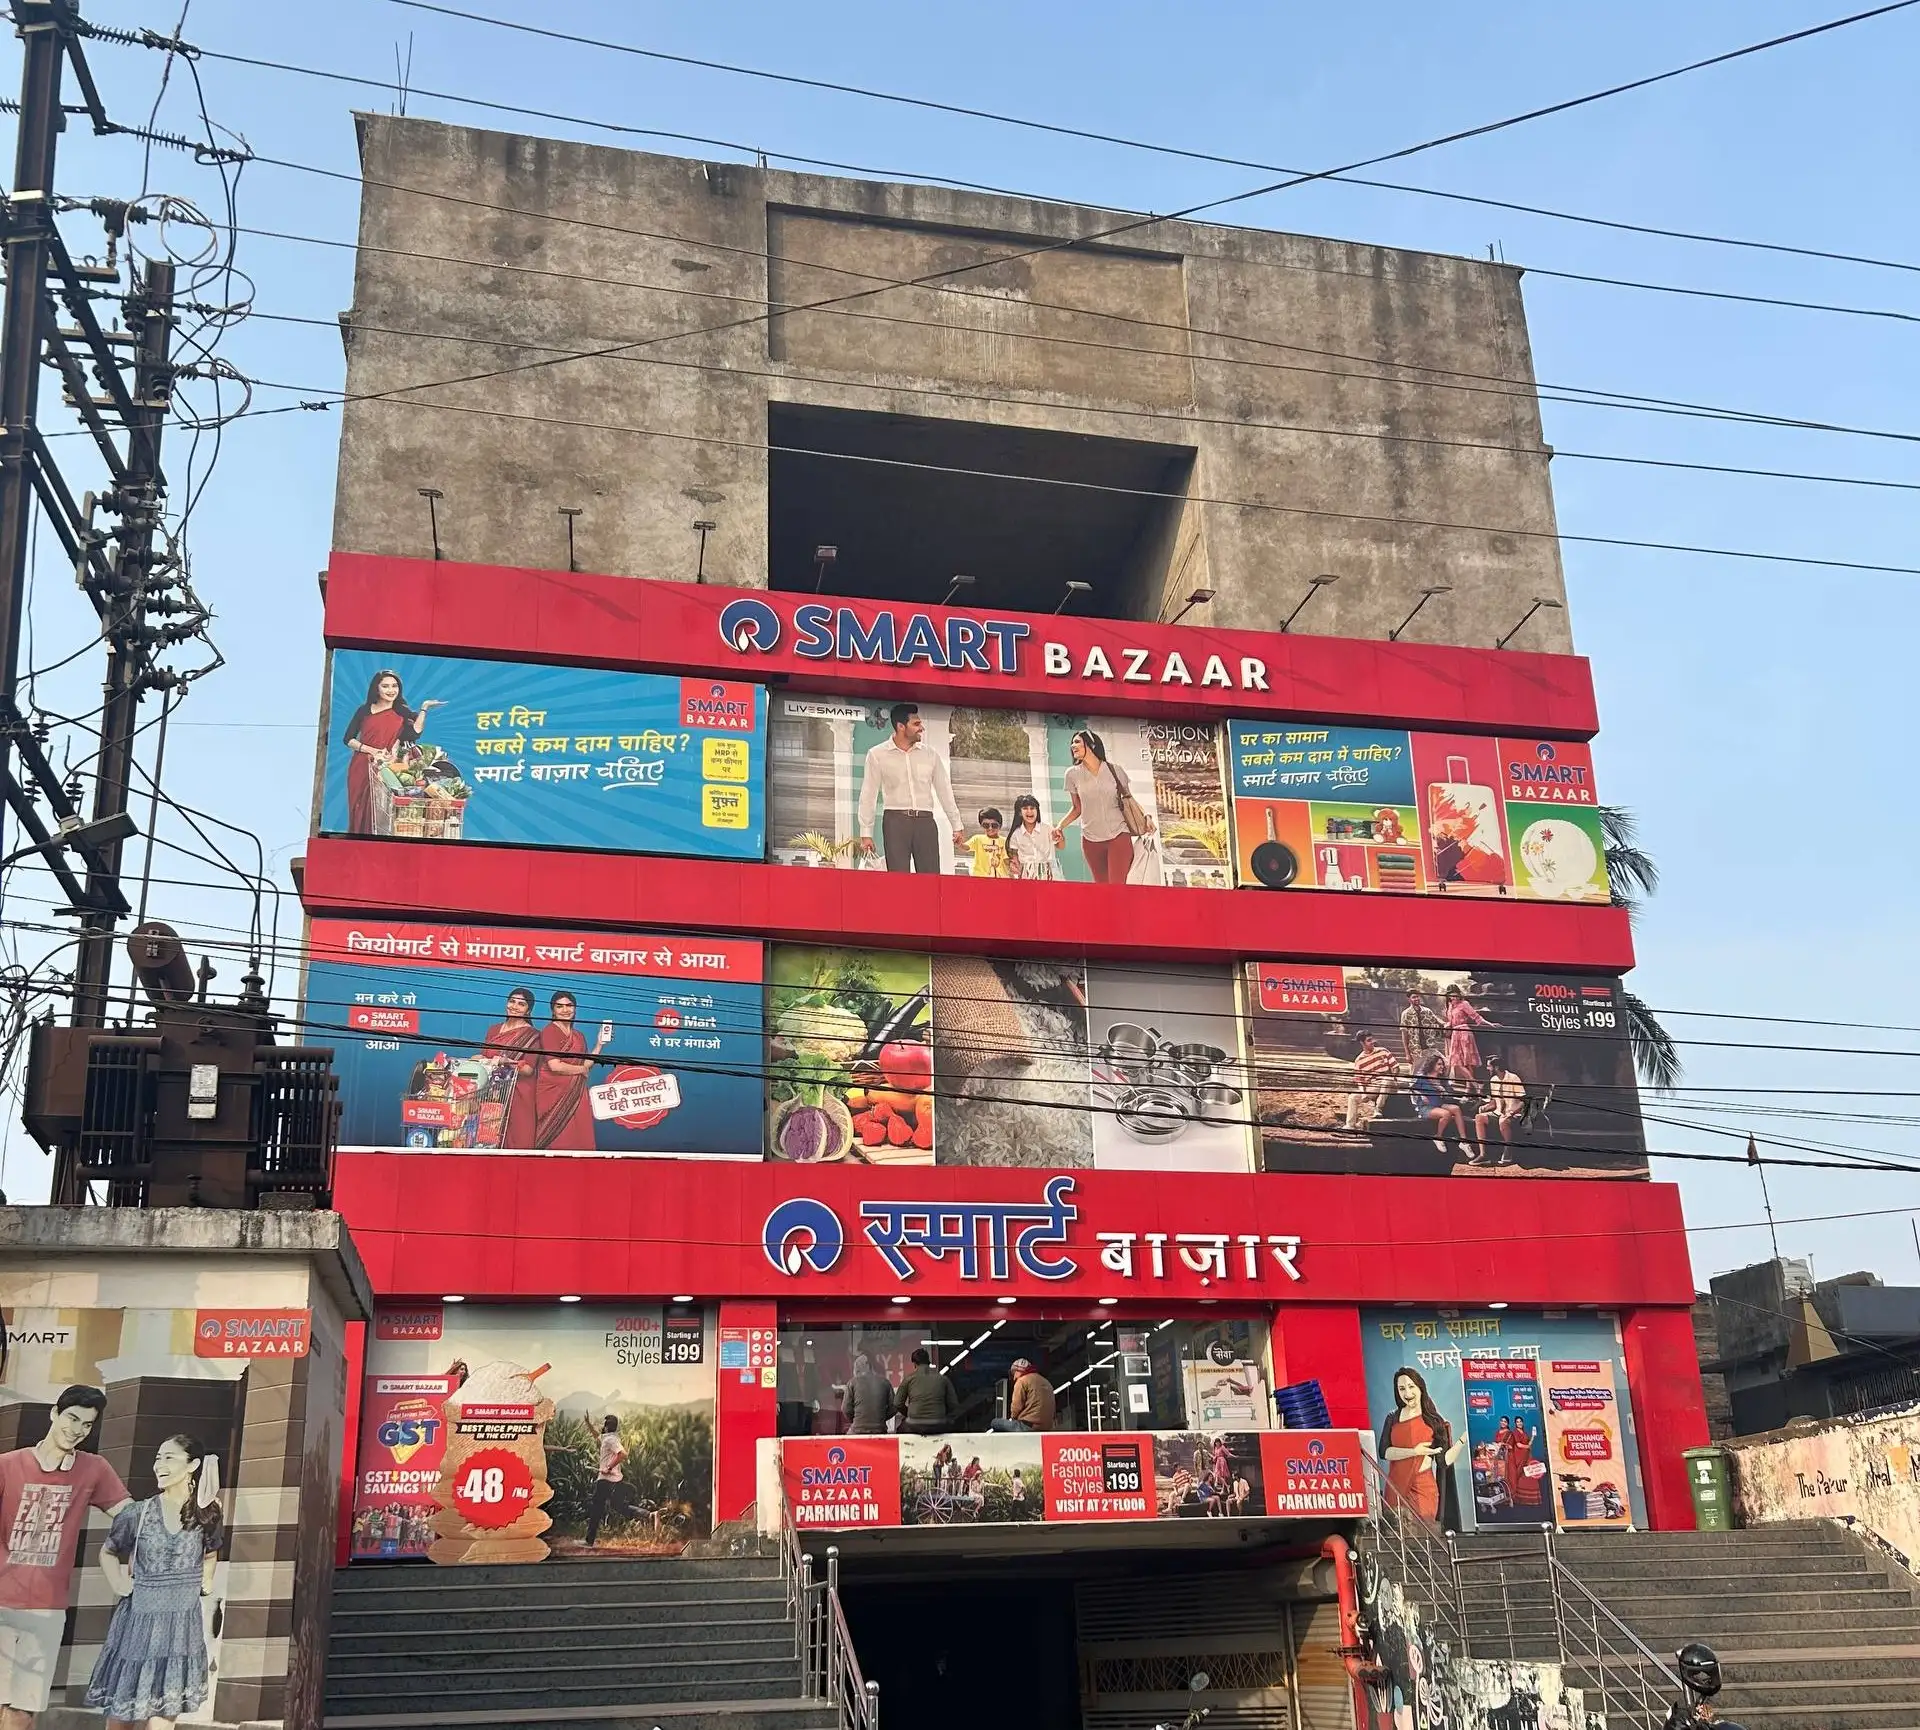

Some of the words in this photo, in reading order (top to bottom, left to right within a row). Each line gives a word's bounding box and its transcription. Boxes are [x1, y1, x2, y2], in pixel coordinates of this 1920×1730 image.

[794, 602, 1029, 674] SMART
[1044, 641, 1271, 692] BAZAAR
[687, 697, 749, 716] SMART
[476, 711, 504, 731] हर
[509, 705, 548, 729] दिन
[686, 714, 748, 728] BAZAAR
[1138, 723, 1210, 741] FASHION
[1240, 734, 1258, 746] घर
[1262, 732, 1282, 745] का
[1285, 731, 1329, 744] सामान
[475, 733, 527, 756] सबसे
[532, 738, 569, 753] कम
[574, 736, 613, 755] दाम
[618, 729, 691, 754] चाहिए?
[714, 748, 731, 757] MRP
[1140, 748, 1211, 765] EVERYDAY
[1241, 749, 1276, 767] सबसे
[1279, 752, 1305, 765] कम
[1308, 750, 1333, 765] दाम
[1337, 745, 1349, 762] में
[1352, 743, 1402, 762] चाहिए?
[474, 759, 526, 783] स्मार्ट
[530, 763, 591, 784] बाज़ार
[595, 756, 665, 782] चलिए
[1242, 769, 1277, 787] स्मार्ट
[1326, 765, 1369, 783] चलिए
[1509, 761, 1588, 785] SMART
[1511, 785, 1591, 802] BAZAAR
[346, 931, 434, 957] जियोमार्ट
[439, 938, 461, 957] से
[535, 941, 584, 963] स्मार्ट
[653, 945, 673, 967] से
[1281, 978, 1337, 993] SMART
[1534, 984, 1577, 999] 2000+
[354, 993, 375, 1003] मन
[377, 991, 399, 1004] करे
[402, 991, 417, 1005] तो
[1282, 993, 1339, 1005] BAZAAR
[371, 1012, 405, 1020] SMART
[371, 1020, 410, 1028] BAZAAR
[657, 1014, 680, 1026] Jio
[684, 1015, 717, 1028] Mart
[1541, 1013, 1581, 1032] Styles
[649, 1034, 661, 1047] से
[664, 1037, 681, 1048] घर
[683, 1035, 722, 1049] मंगाओ
[597, 1086, 618, 1101] वही
[608, 1097, 629, 1111] वही
[860, 1175, 1077, 1281] स्मार्ट
[1097, 1231, 1302, 1287] बाज़ार
[225, 1318, 305, 1338] SMART
[392, 1326, 439, 1335] BAZAAR
[615, 1317, 660, 1332] 2000+
[1379, 1321, 1408, 1341] घर
[1412, 1320, 1439, 1340] का
[1444, 1317, 1502, 1339] सामान
[605, 1332, 661, 1348] Fashion
[667, 1332, 692, 1340] Starting
[224, 1341, 304, 1353] BAZAAR
[617, 1350, 660, 1367] Styles
[1416, 1342, 1462, 1369] सबसे
[377, 1418, 441, 1447] GST
[484, 1425, 505, 1433] RICE
[506, 1425, 533, 1433] PRICE
[1568, 1433, 1605, 1441] EXCHANGE
[1059, 1448, 1100, 1462] 2000+
[1051, 1462, 1102, 1478] Fashion
[1106, 1461, 1129, 1469] Starting
[1286, 1457, 1349, 1476] SMART
[365, 1470, 392, 1483] GST
[802, 1466, 872, 1486] SMART
[1287, 1478, 1352, 1490] BAZAAR
[364, 1482, 419, 1494] SAVINGS
[1063, 1479, 1103, 1497] Styles
[1794, 1472, 1816, 1498] The
[801, 1487, 873, 1501] BAZAAR
[1277, 1493, 1336, 1510] PARKING
[1338, 1492, 1365, 1509] OUT
[15, 1500, 71, 1523] FAST
[1055, 1499, 1085, 1512] VISIT
[1086, 1498, 1100, 1512] AT
[1113, 1497, 1146, 1511] FLOOR
[796, 1504, 860, 1523] PARKING
[863, 1503, 879, 1521] IN
[8, 1530, 62, 1553] HARD
